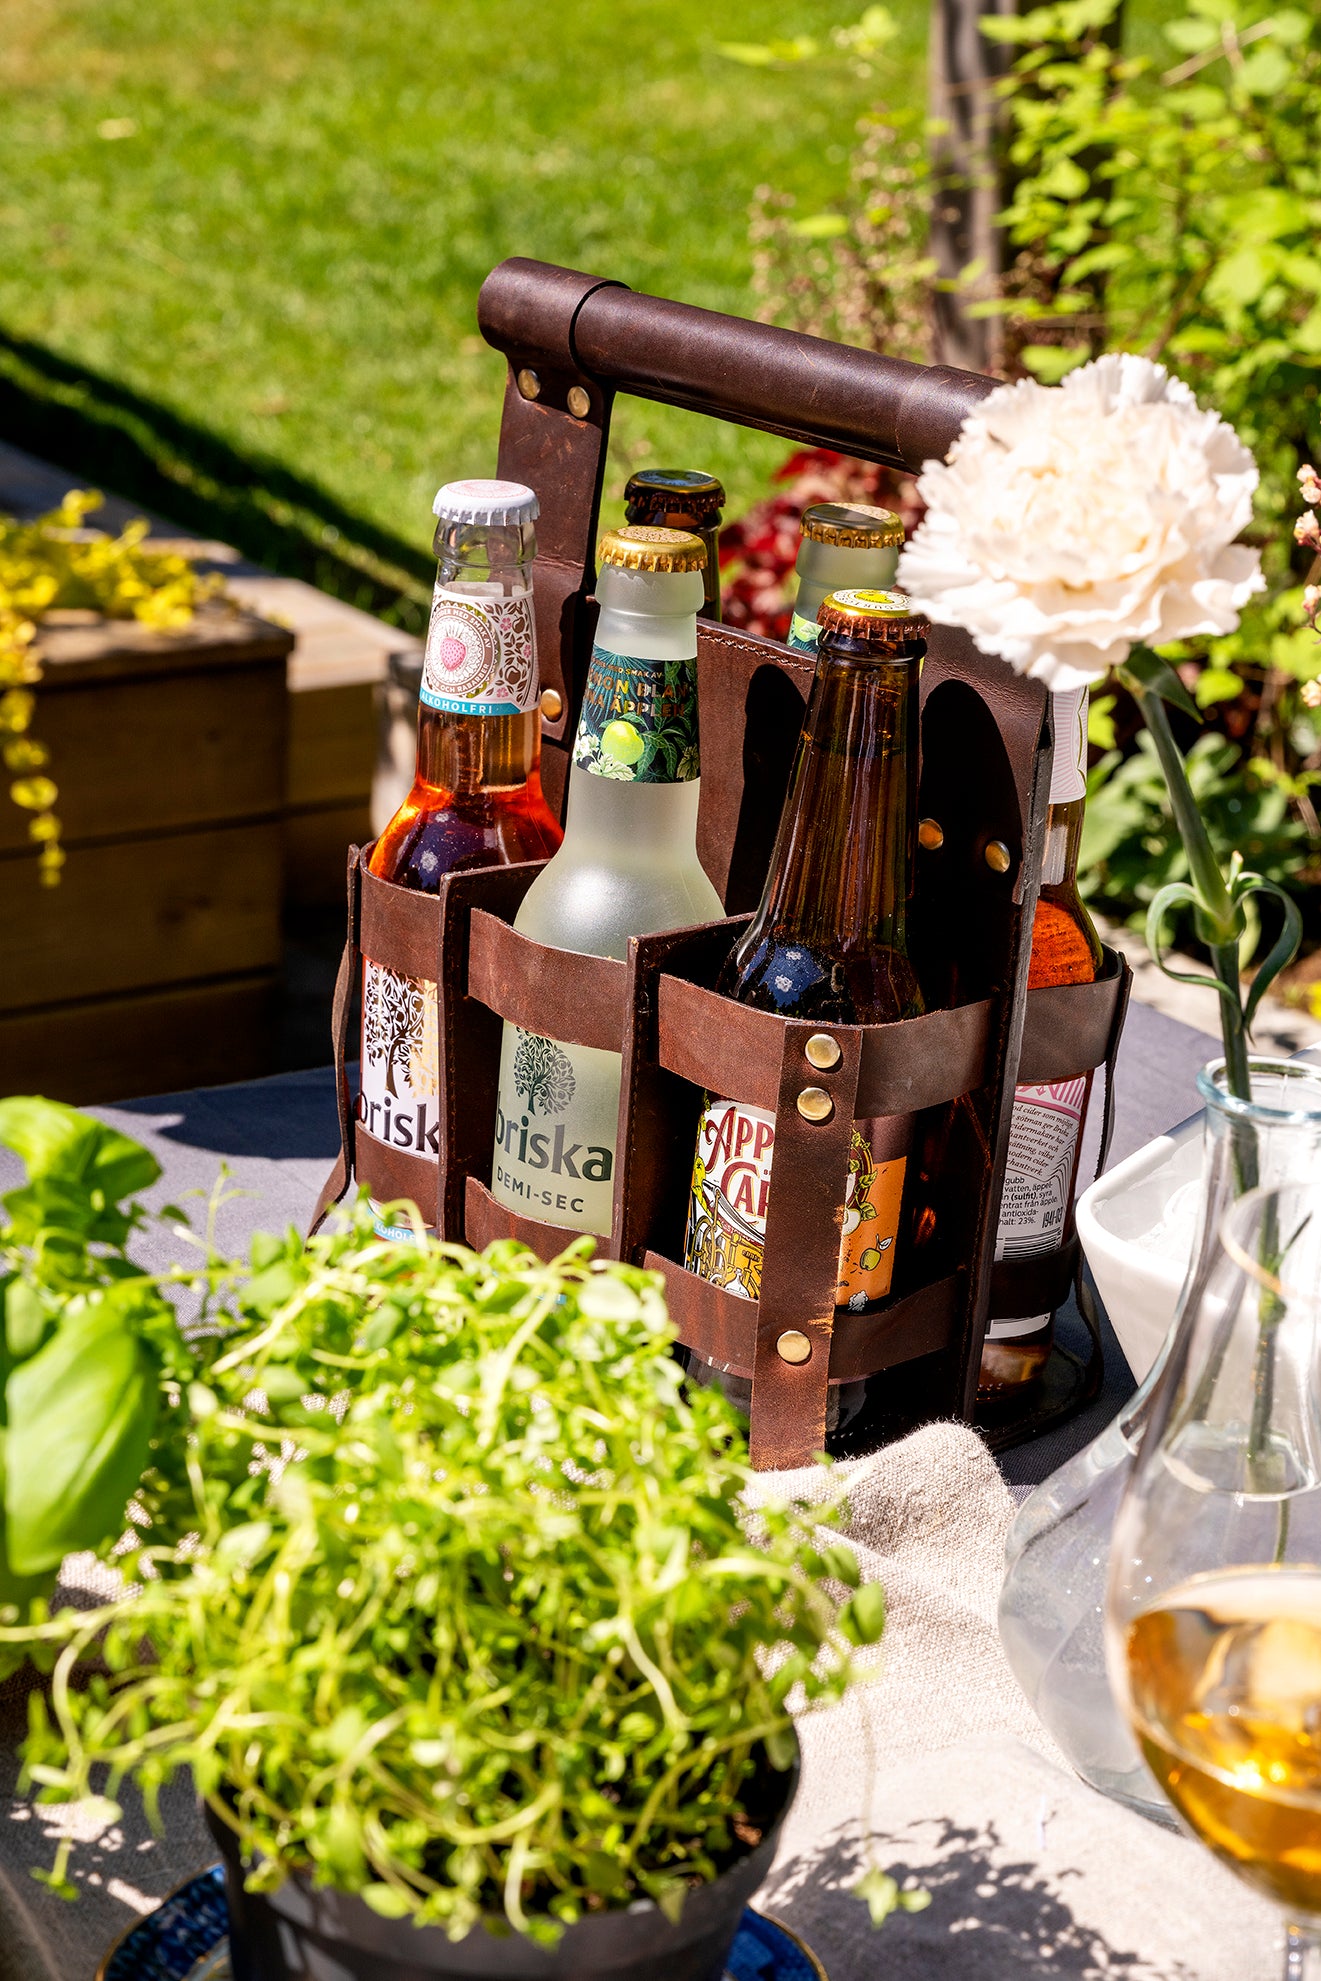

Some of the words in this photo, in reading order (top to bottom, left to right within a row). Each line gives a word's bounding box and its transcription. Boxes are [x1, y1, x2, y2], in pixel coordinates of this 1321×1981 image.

[469, 617, 488, 637] SMAK
[440, 685, 456, 693] OCH
[456, 663, 490, 693] RABARBER
[625, 668, 650, 678] SMAK
[421, 691, 493, 714] ALKOHOLFRI
[609, 692, 686, 717] ÄPPLEN
[1023, 1106, 1042, 1117] cider
[1042, 1112, 1056, 1121] som
[1042, 1122, 1054, 1130] ger
[1011, 1122, 1056, 1141] cidermakare
[1055, 1136, 1065, 1145] har
[1010, 1130, 1048, 1147] hantverket
[1048, 1143, 1060, 1153] och
[1037, 1149, 1055, 1161] vilket
[1032, 1157, 1049, 1168] cider
[496, 1165, 585, 1213] DEMI-SEC
[1004, 1185, 1032, 1193] vatten,
[1038, 1190, 1053, 1200] syra
[1024, 1199, 1039, 1209] från
[1001, 1208, 1039, 1218] antioxida-
